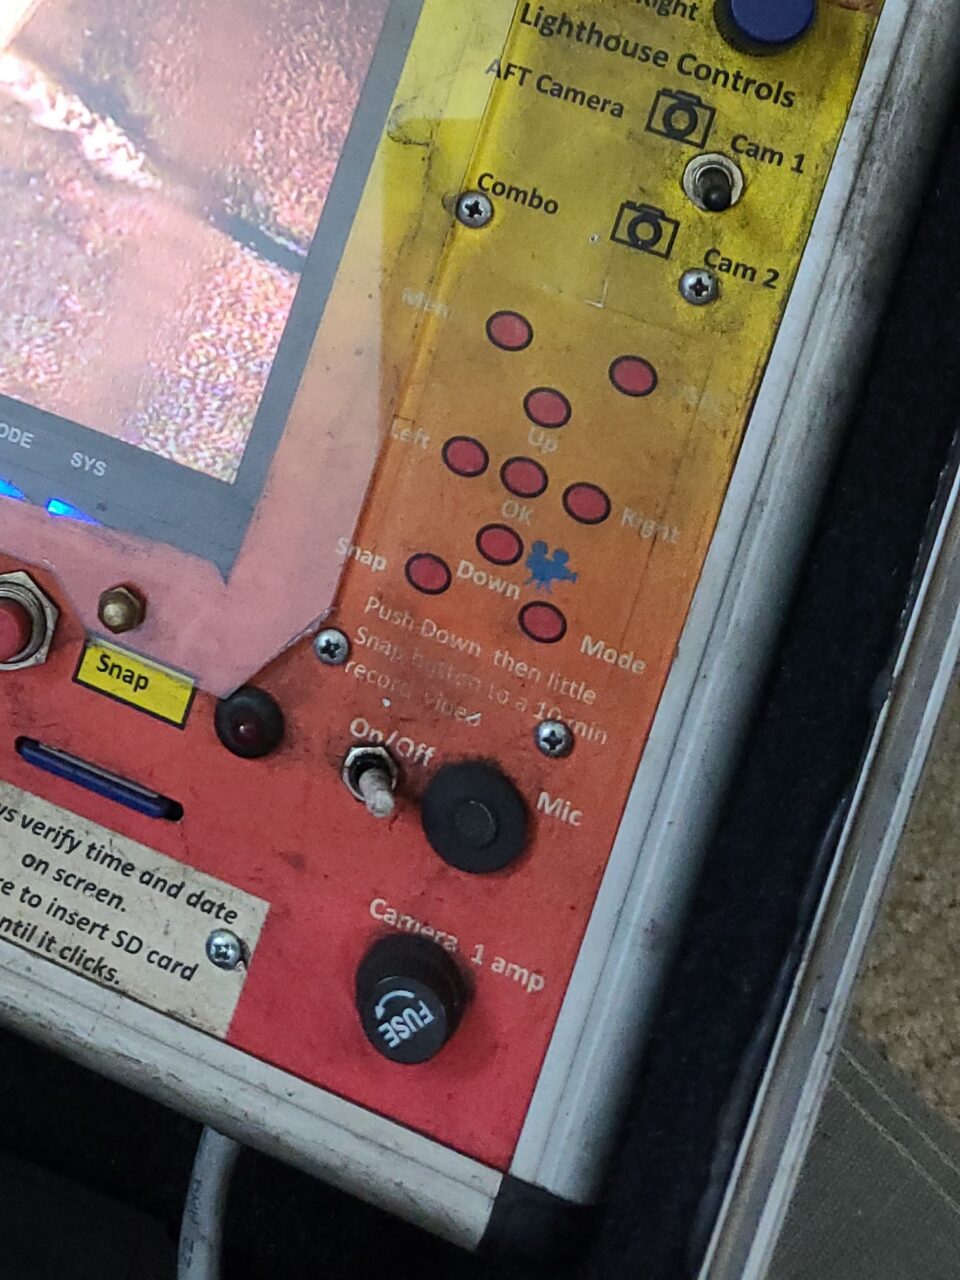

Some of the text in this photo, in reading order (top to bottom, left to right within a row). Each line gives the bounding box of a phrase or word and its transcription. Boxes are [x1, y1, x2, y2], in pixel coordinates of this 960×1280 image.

[519, 3, 796, 108] Lighthouse Controls
[484, 58, 626, 120] AFT Camera
[730, 133, 805, 173] Cam 1
[476, 173, 560, 215] Combo
[703, 248, 780, 290] Cam 2
[527, 427, 558, 454] Up
[70, 451, 108, 477] SYS
[501, 499, 534, 524] OK
[335, 537, 388, 573] Snap
[457, 559, 521, 600] Down
[354, 625, 403, 663] Snap
[364, 596, 597, 705] Push Down then little
[579, 634, 646, 674] Mode
[96, 652, 150, 691] Snap
[350, 717, 437, 768] On/Off
[536, 790, 583, 828] Mic
[20, 813, 83, 856] verify
[84, 841, 136, 878] time
[139, 868, 186, 901] and
[186, 888, 239, 925] date
[20, 851, 128, 913] on screen.
[19, 883, 43, 908] to
[45, 897, 108, 944] insert
[111, 928, 144, 956] SD
[146, 948, 200, 983] card
[370, 896, 545, 994] Camera 1 amp
[40, 930, 57, 952] it
[58, 938, 122, 987] clicks.
[378, 999, 435, 1049] FUSE
